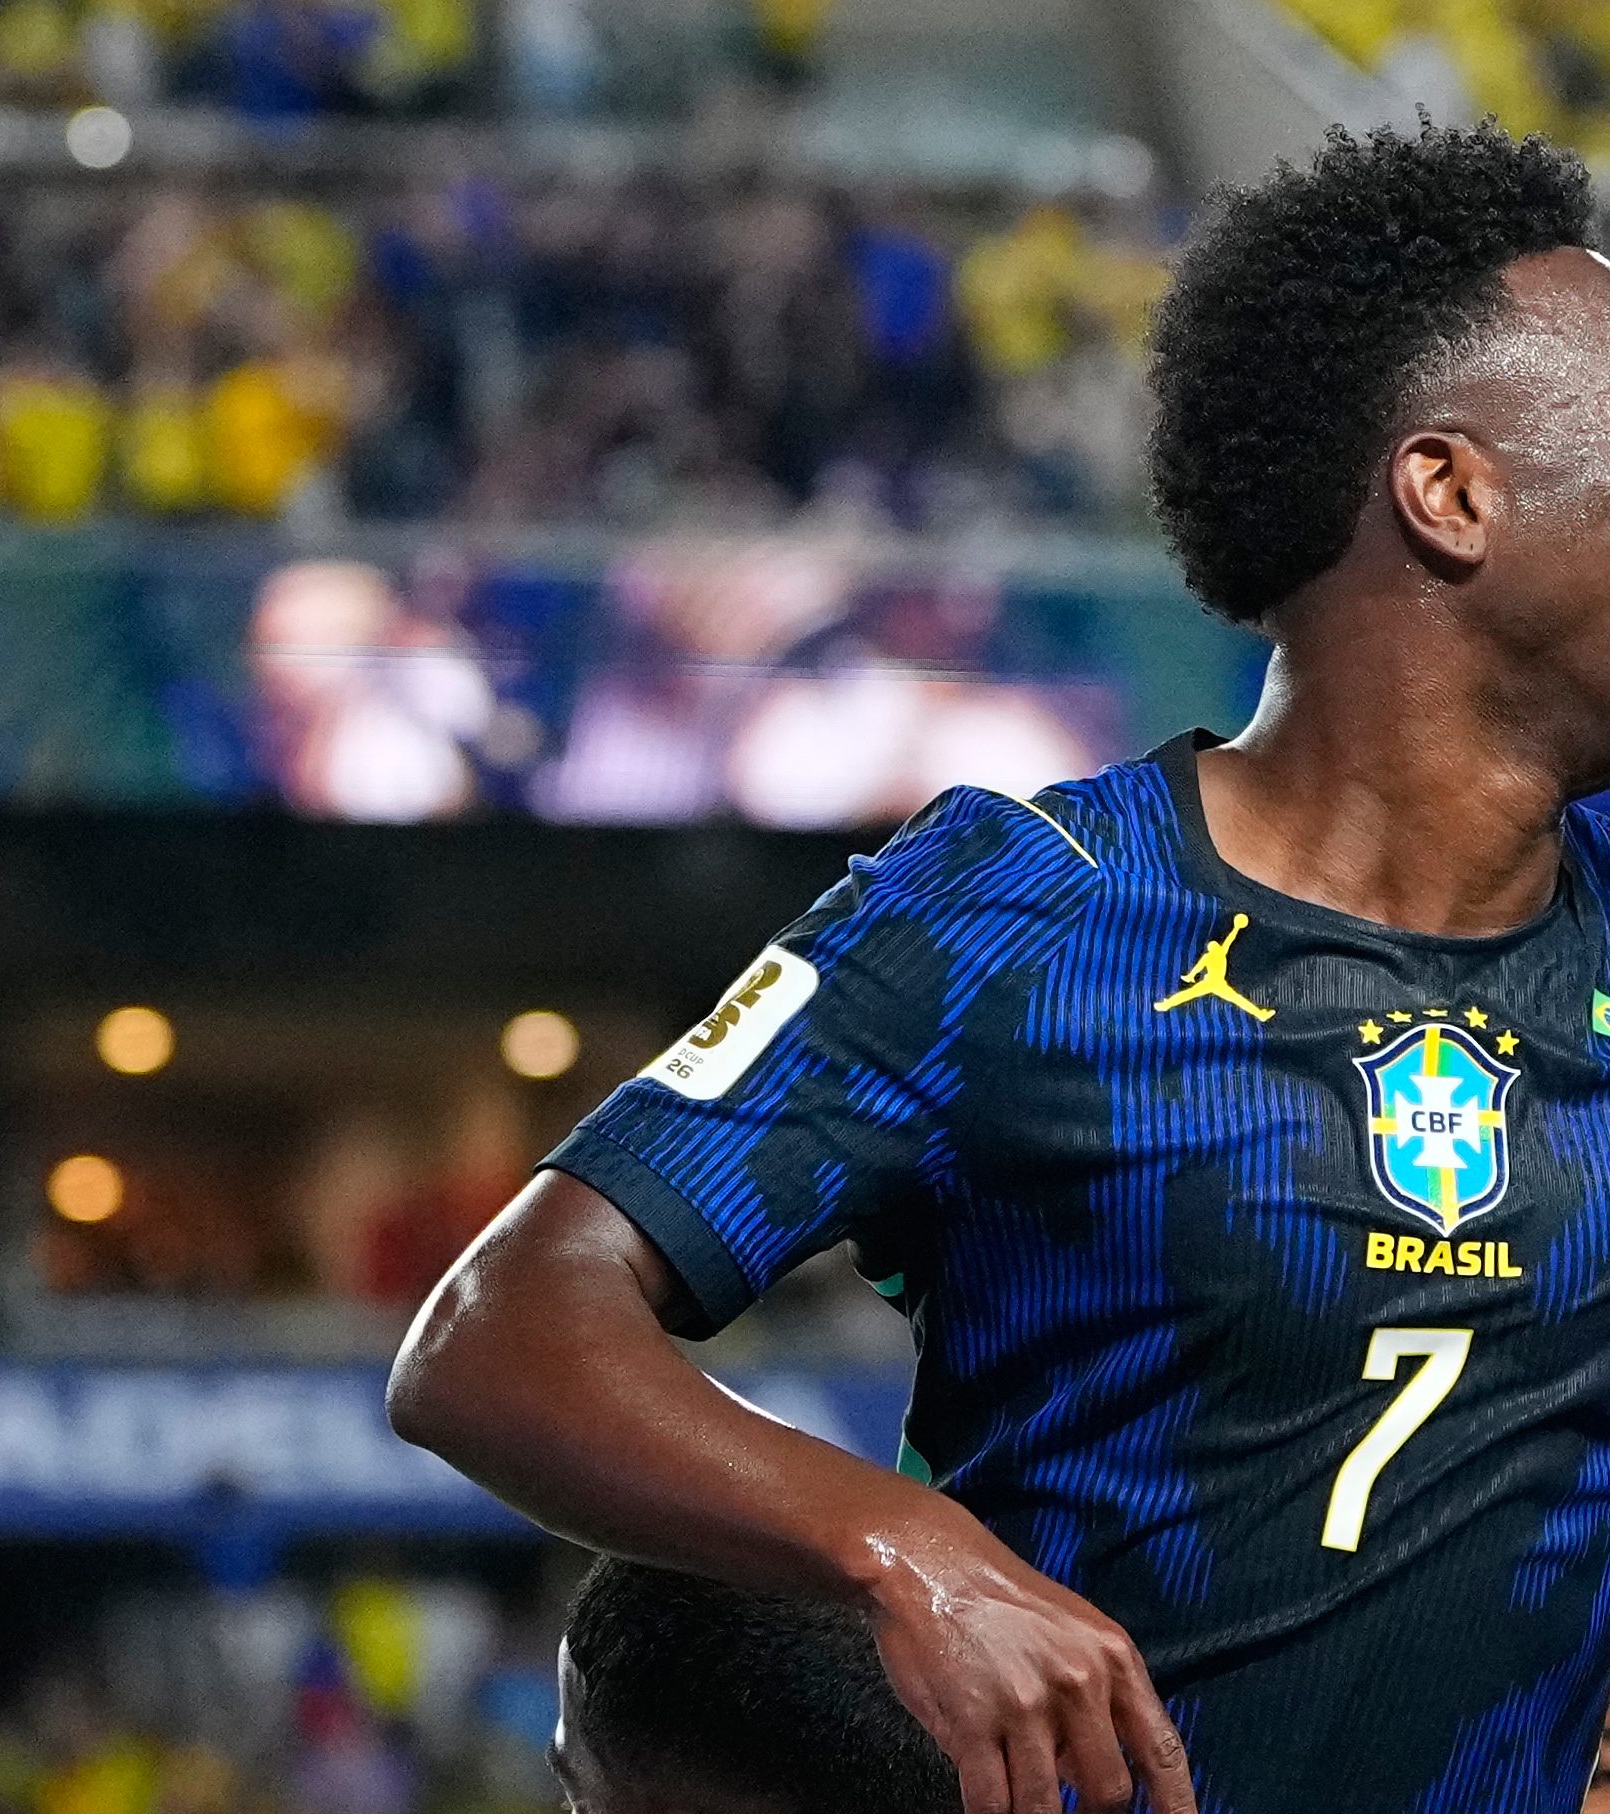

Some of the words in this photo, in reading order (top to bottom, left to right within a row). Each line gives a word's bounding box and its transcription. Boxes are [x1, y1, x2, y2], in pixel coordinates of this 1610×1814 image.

[1411, 1111, 1463, 1134] CBF
[1366, 1232, 1523, 1278] BRASIL
[1320, 1328, 1474, 1553] 7
